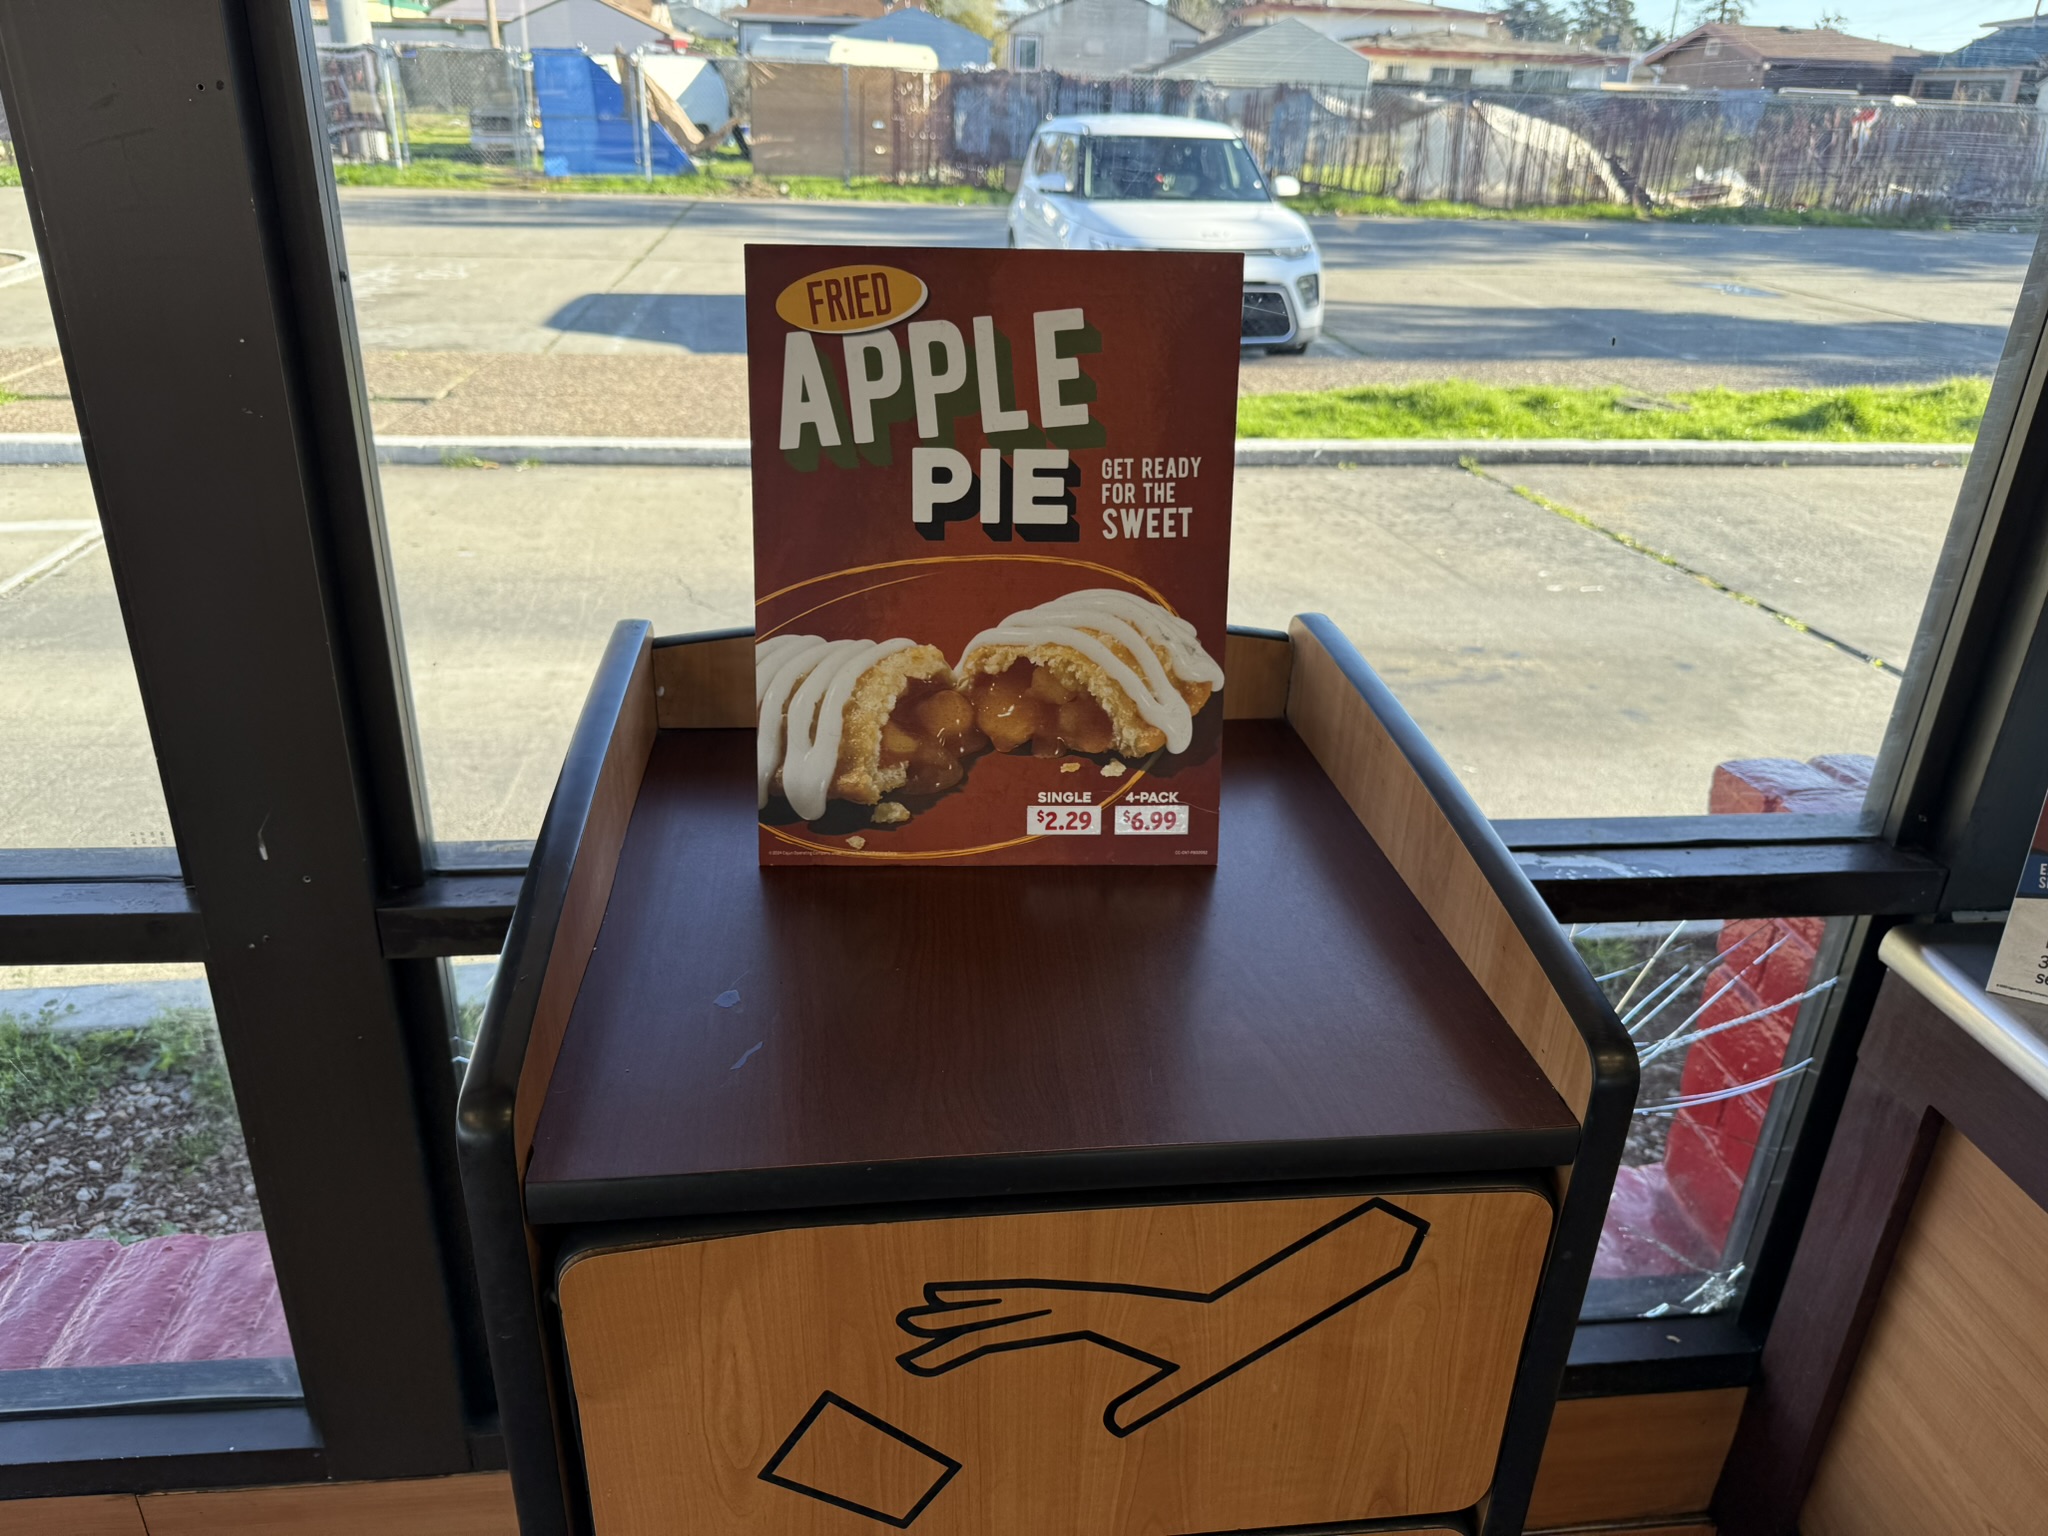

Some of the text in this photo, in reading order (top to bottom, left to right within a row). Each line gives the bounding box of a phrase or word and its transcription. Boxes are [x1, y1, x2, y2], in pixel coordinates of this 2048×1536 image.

[806, 271, 893, 325] FRIED
[778, 307, 1090, 451] APPLE
[1101, 456, 1203, 480] GET READY
[911, 447, 1070, 525] PIE
[1101, 481, 1176, 505] FOR THE
[1101, 506, 1193, 541] SWEET
[1037, 791, 1092, 804] SINGLE
[1125, 791, 1179, 804] 4-PACK
[1036, 810, 1092, 831] $2.29
[1122, 809, 1178, 831] $6.99
